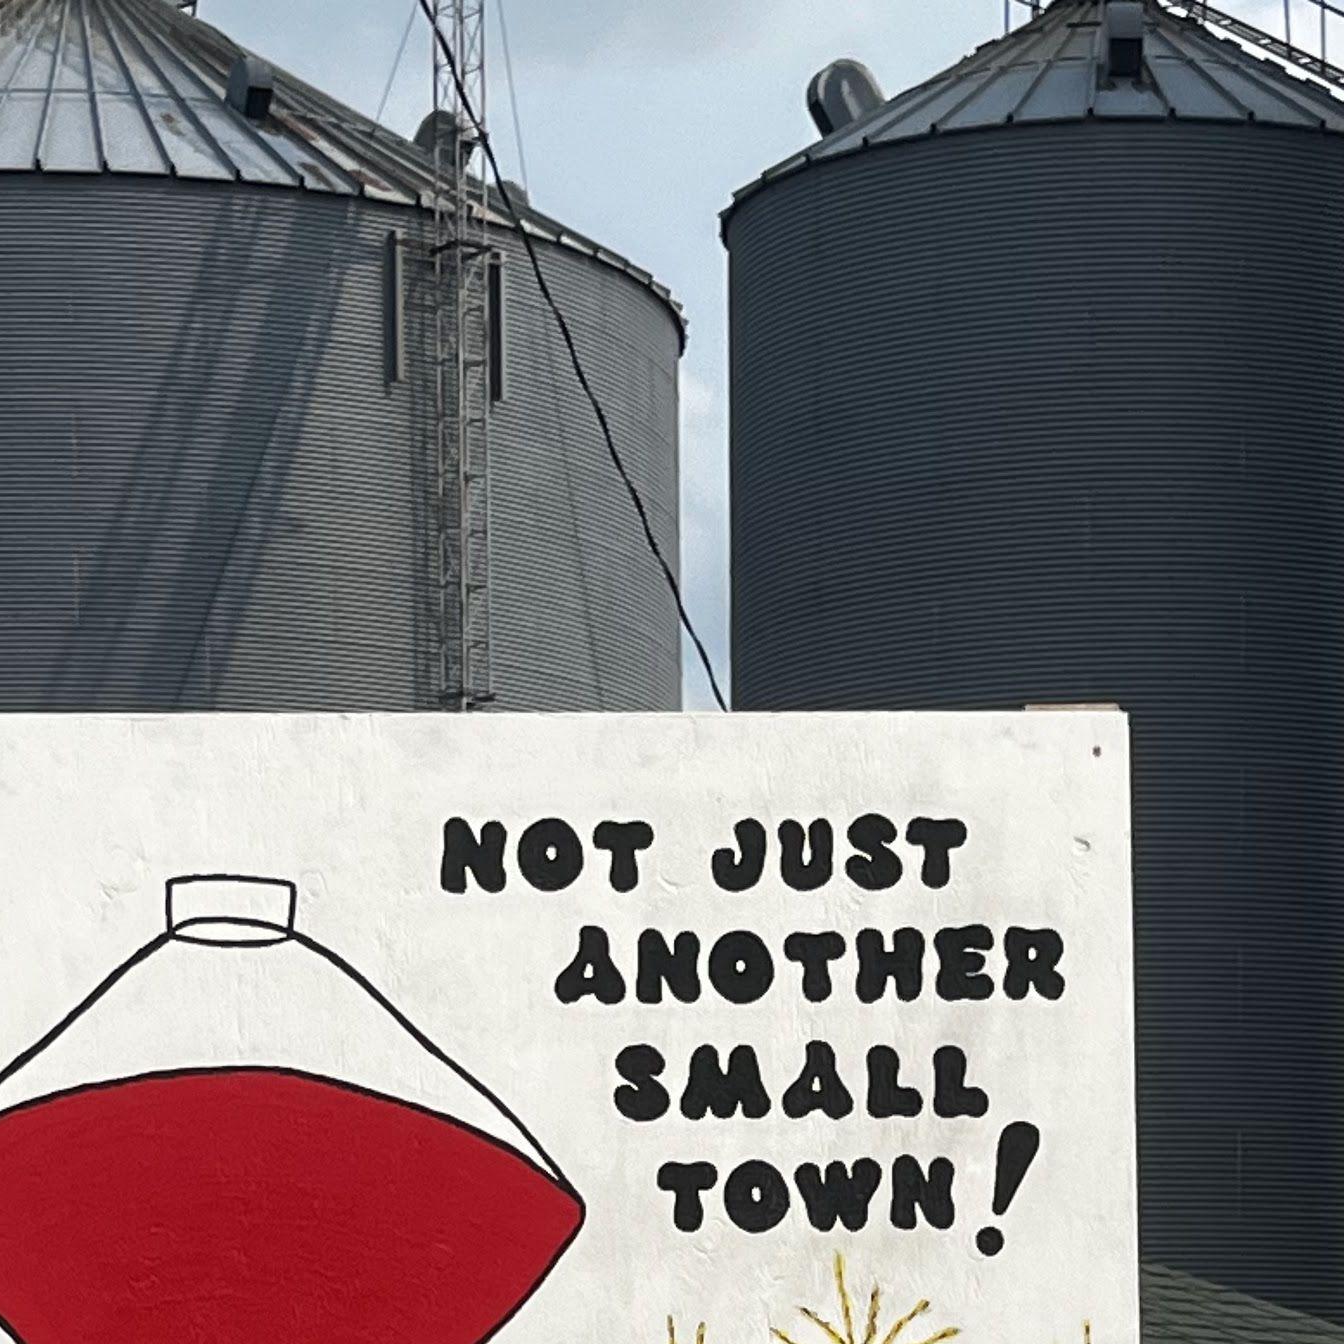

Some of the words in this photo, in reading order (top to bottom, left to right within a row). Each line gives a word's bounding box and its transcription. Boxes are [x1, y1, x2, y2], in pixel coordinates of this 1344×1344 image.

[440, 817, 654, 893] NOT
[711, 813, 967, 892] JUST
[554, 925, 1065, 1004] ANOTHER
[614, 1041, 989, 1121] SMALL
[657, 1121, 1040, 1256] TOWN!
